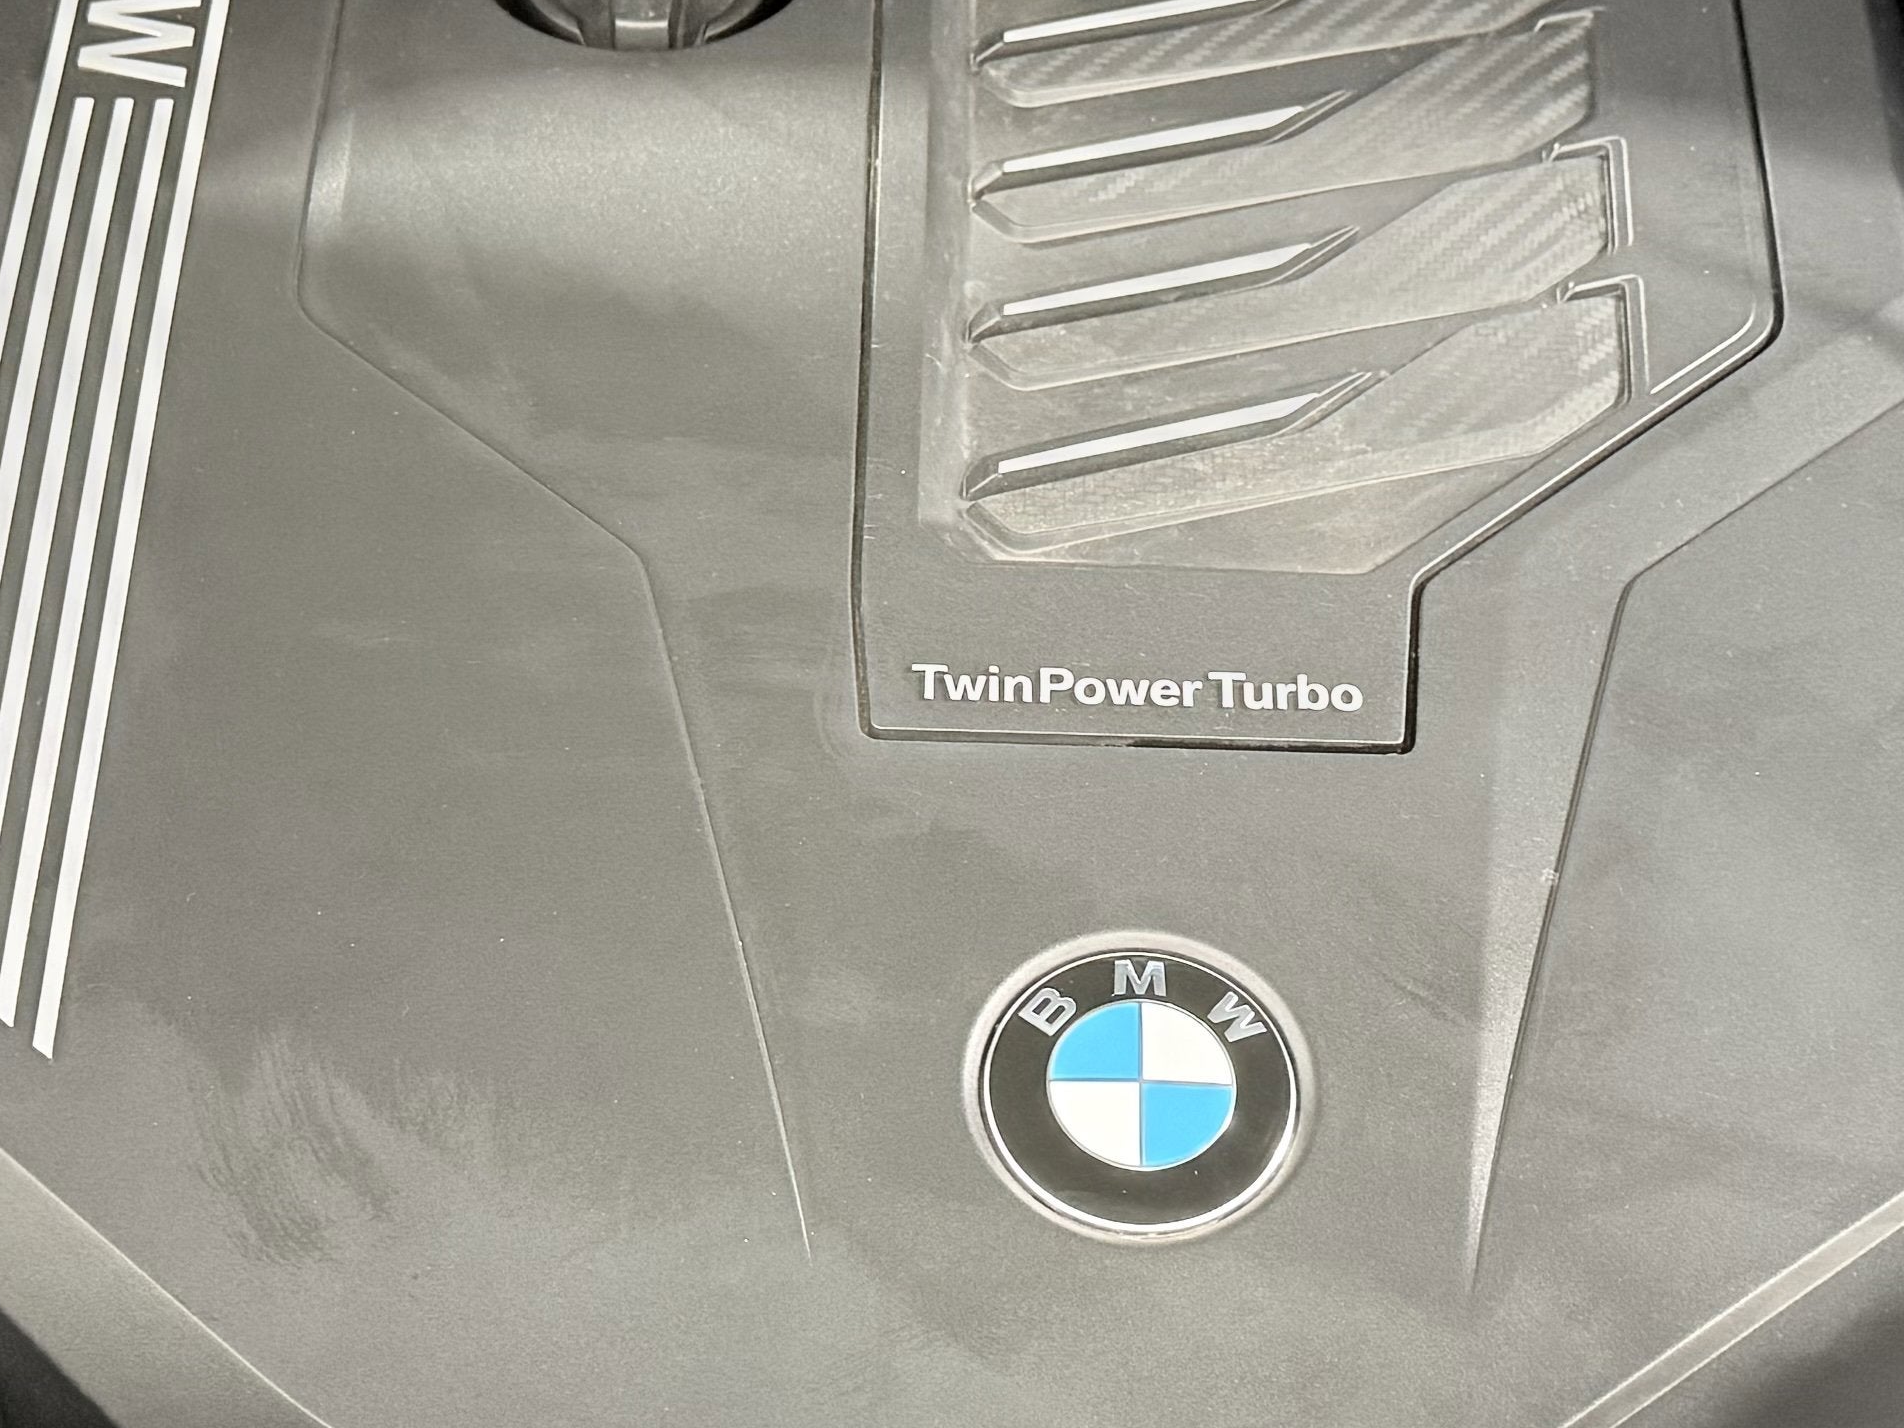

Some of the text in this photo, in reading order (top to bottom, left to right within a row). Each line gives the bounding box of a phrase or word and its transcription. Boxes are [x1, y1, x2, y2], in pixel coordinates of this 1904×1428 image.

[911, 663, 1364, 712] TwinPower Turbo
[1020, 958, 1268, 1043] BMW
